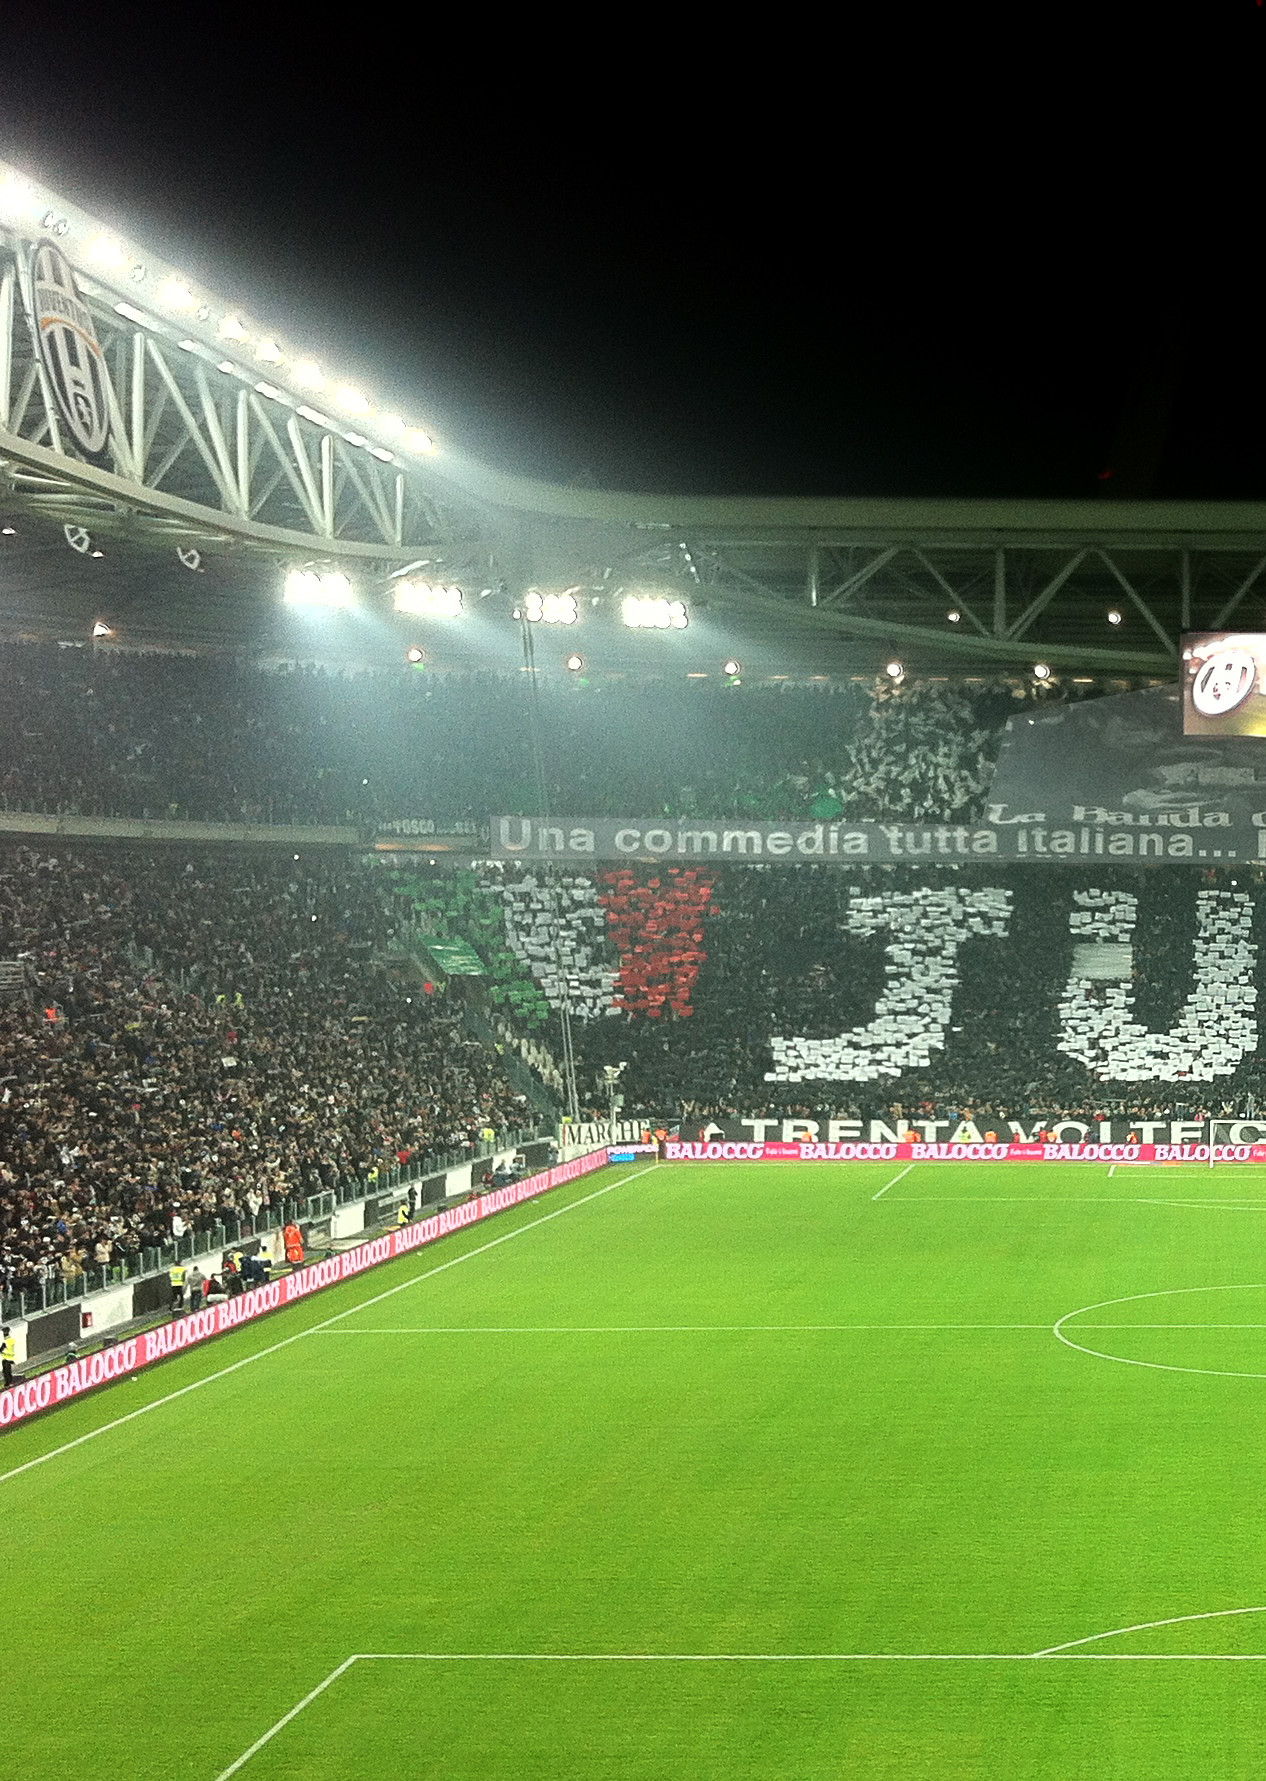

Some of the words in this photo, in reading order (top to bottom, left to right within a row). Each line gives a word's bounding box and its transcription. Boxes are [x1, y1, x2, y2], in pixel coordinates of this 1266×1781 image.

[500, 816, 595, 851] Una
[614, 823, 869, 855] commedia
[881, 824, 998, 855] tutta
[740, 1118, 985, 1144] TRENTA
[1007, 1120, 1205, 1145] VOLTE
[666, 1143, 764, 1159] BALOCCO
[799, 1143, 898, 1160] BALOCCO
[911, 1144, 1009, 1160] BALOCCO
[1043, 1144, 1141, 1161] BALOCCO
[1155, 1145, 1251, 1161] BALOCCO
[395, 1216, 438, 1253] BALOCCO
[439, 1200, 478, 1236] BALOCCO
[342, 1236, 391, 1281] BALOCCO
[285, 1255, 341, 1300] BALOCCO
[218, 1281, 281, 1330] BALOCCO
[145, 1307, 216, 1362] BALOCCO
[54, 1339, 137, 1399] BALOCCO
